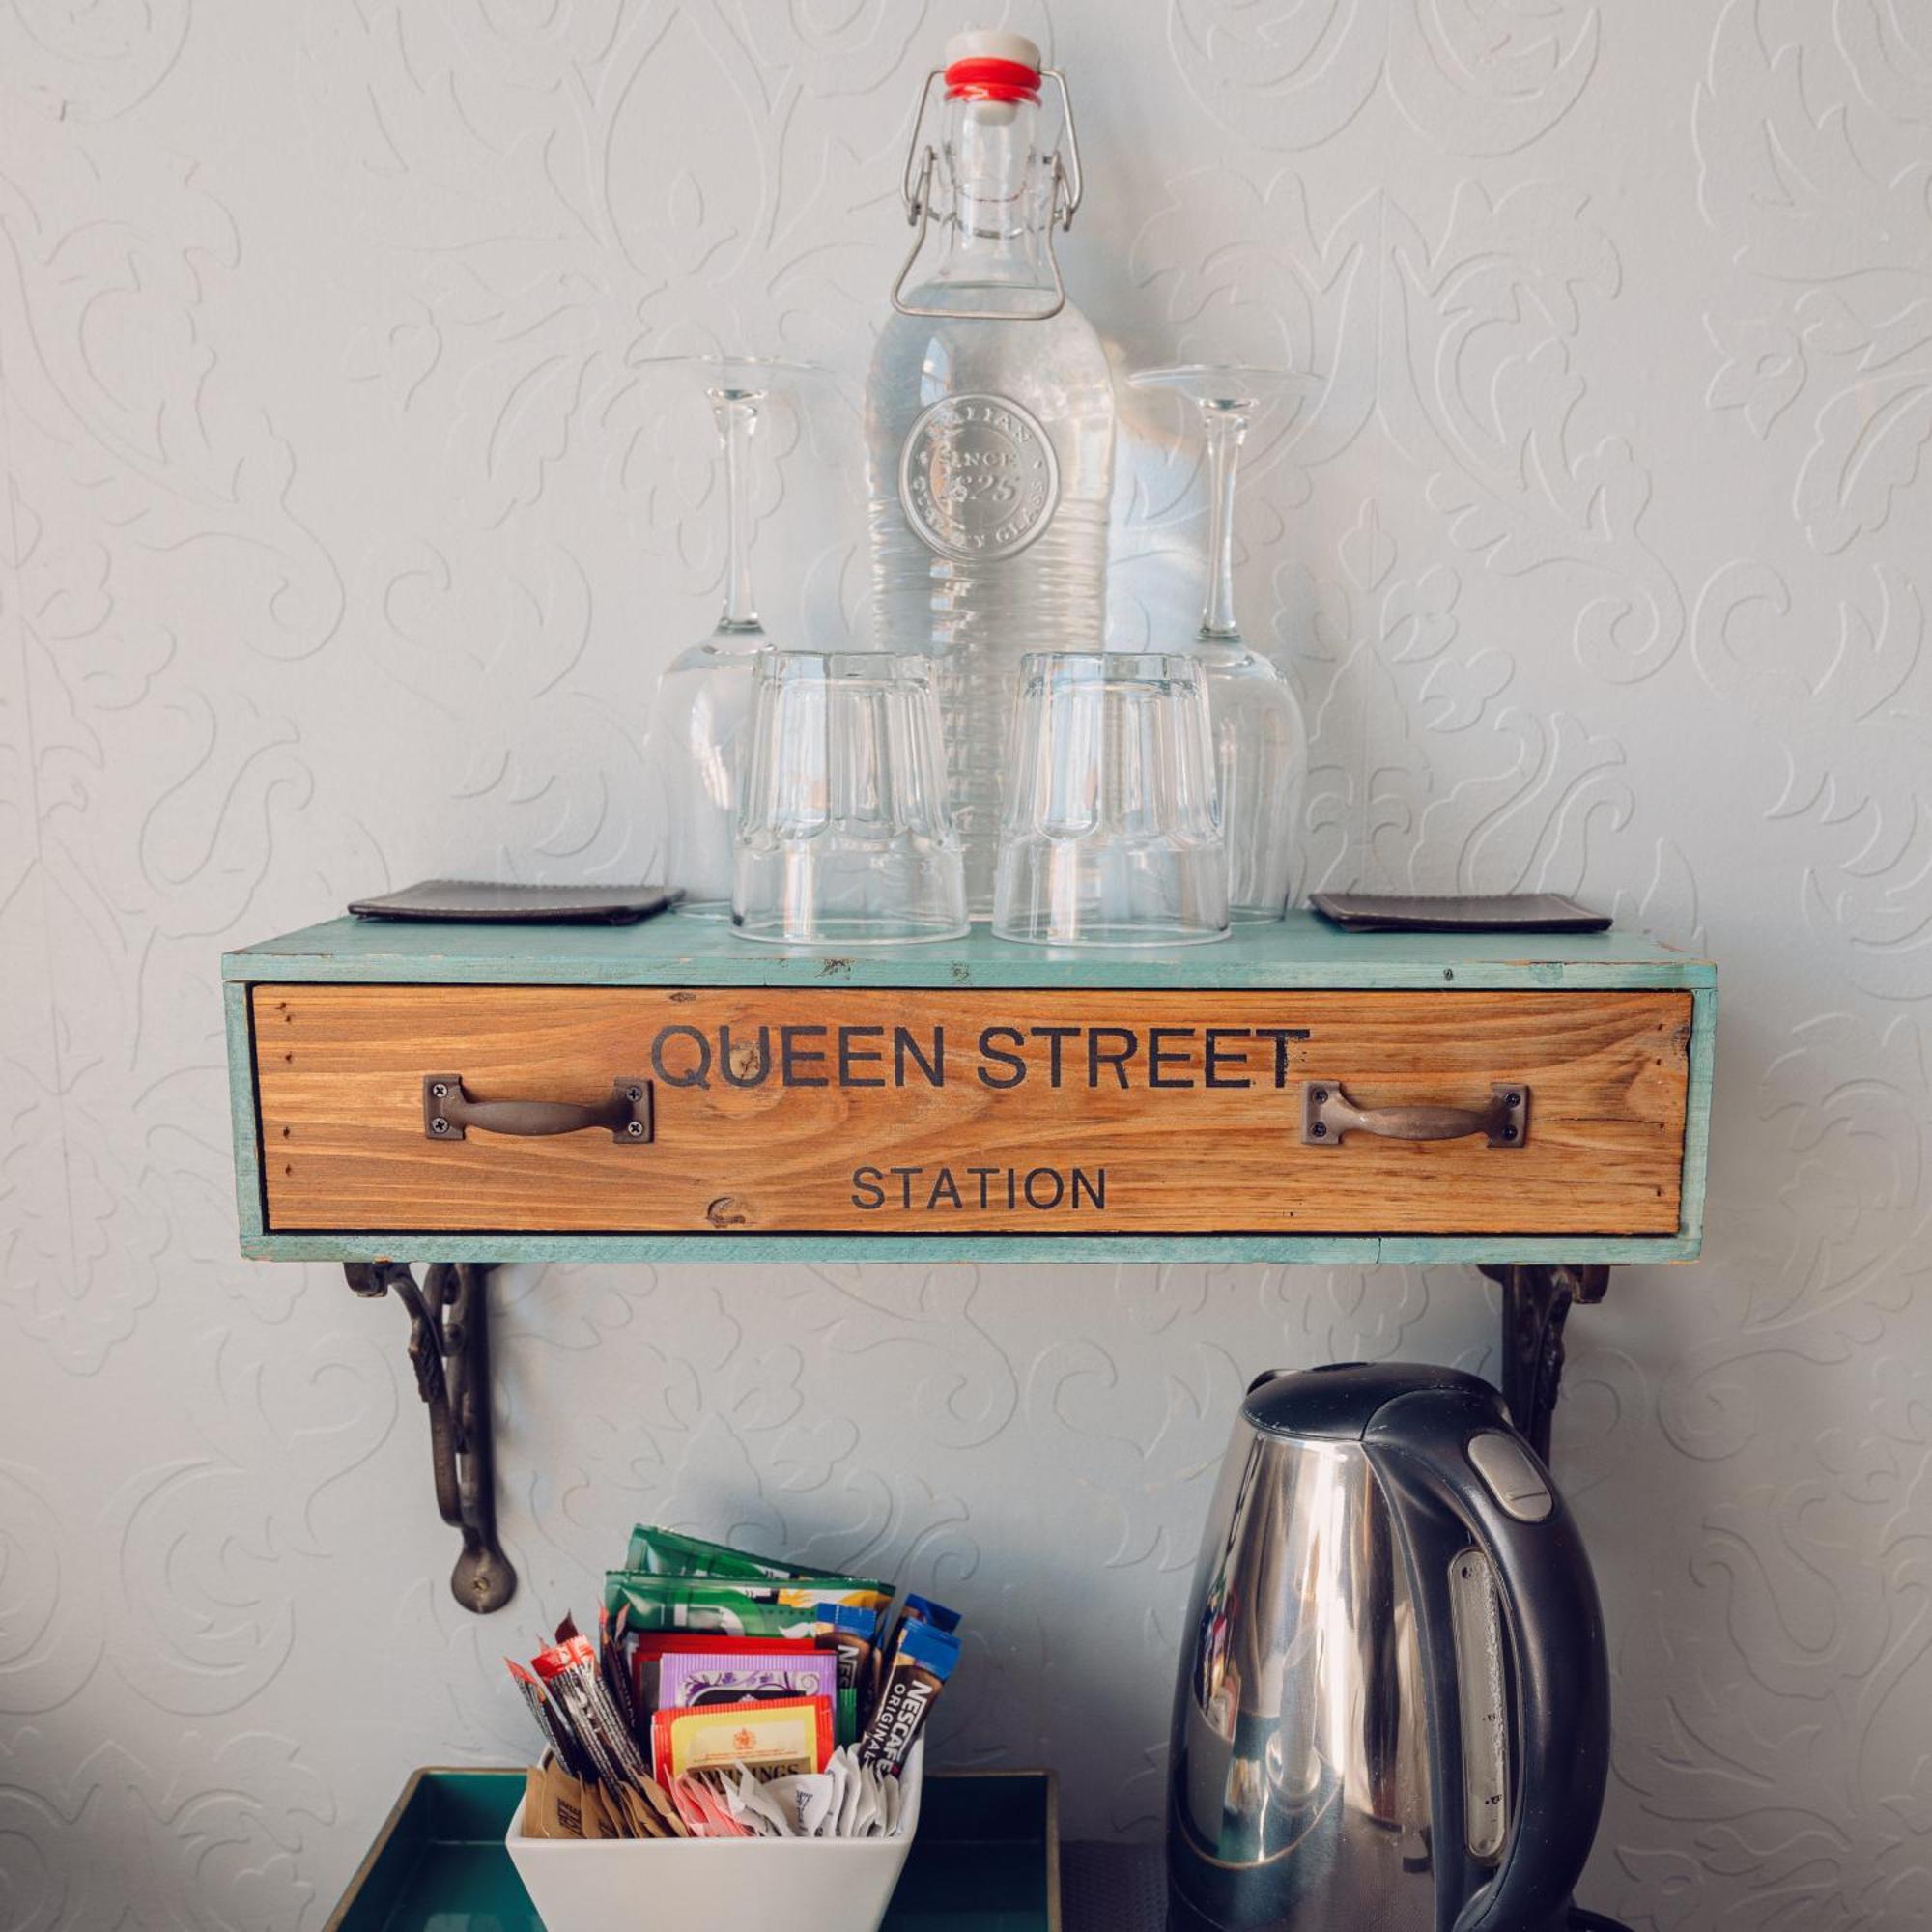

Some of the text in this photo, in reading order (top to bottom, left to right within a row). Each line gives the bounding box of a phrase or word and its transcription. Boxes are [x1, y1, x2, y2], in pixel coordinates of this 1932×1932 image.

[941, 474, 1016, 502] 825
[651, 1025, 1310, 1092] QUEEN STREET
[851, 1166, 1106, 1210] STATION
[864, 1683, 906, 1760] ORIGINAL
